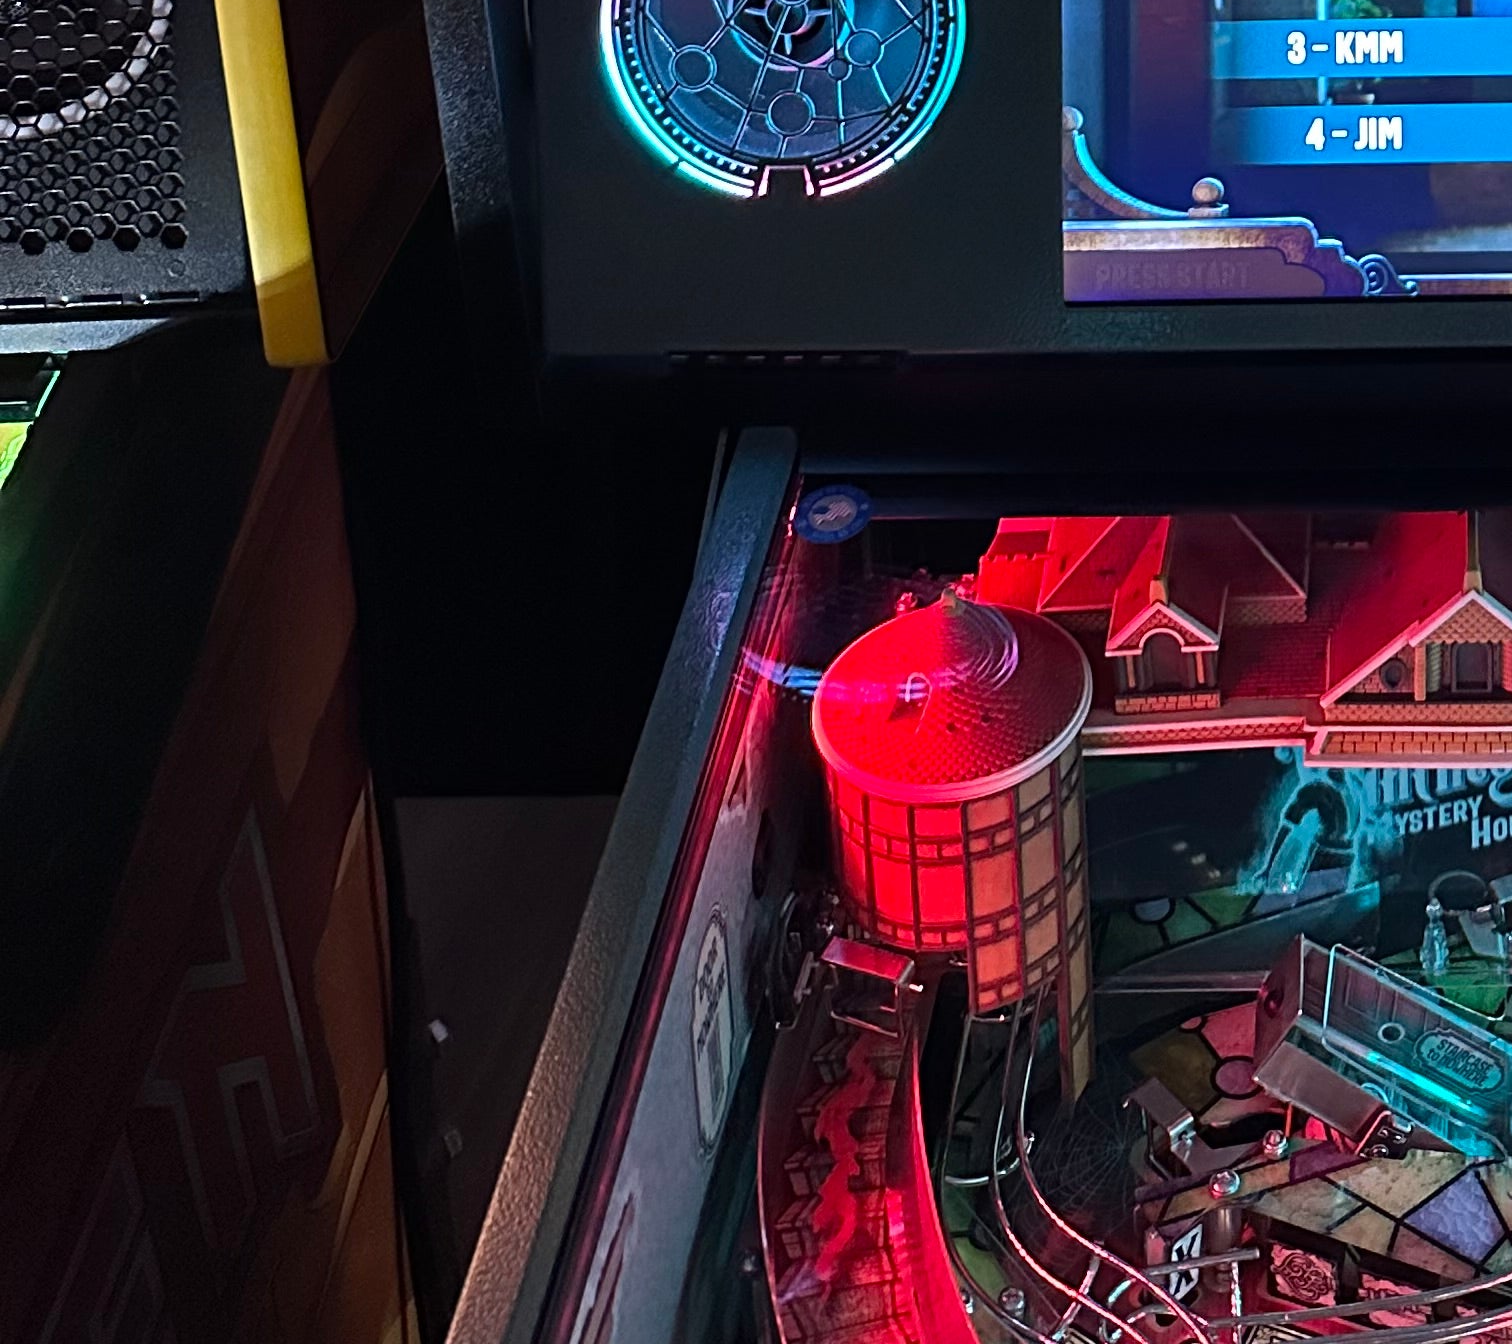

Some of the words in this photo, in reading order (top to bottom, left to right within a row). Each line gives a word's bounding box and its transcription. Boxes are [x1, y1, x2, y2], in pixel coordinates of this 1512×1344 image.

[1287, 31, 1306, 64] 3
[1336, 31, 1404, 64] KMM
[1305, 118, 1325, 150] 4
[1354, 116, 1402, 150] JIM
[1437, 1038, 1493, 1074] STAIRCASE
